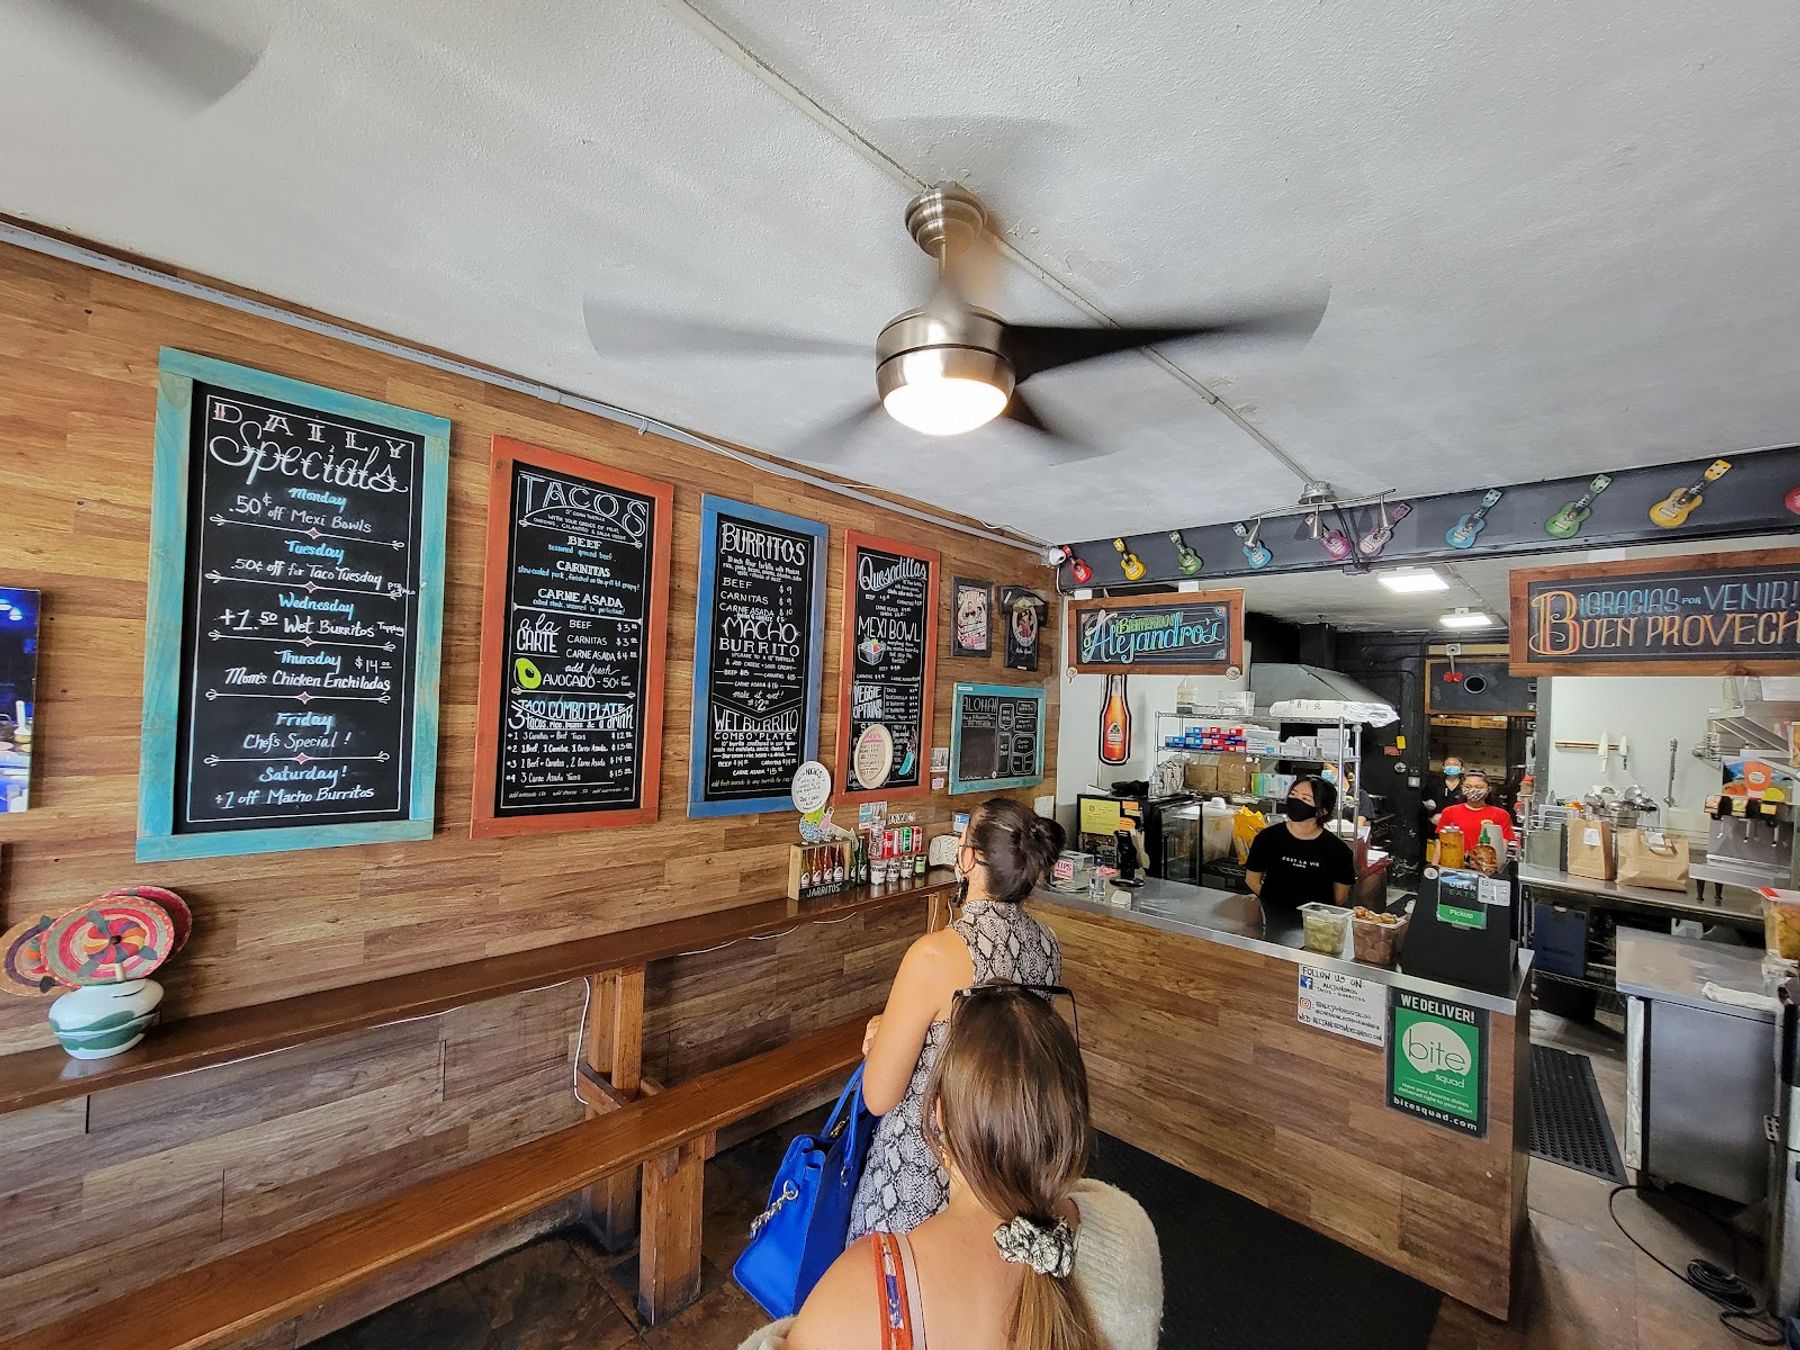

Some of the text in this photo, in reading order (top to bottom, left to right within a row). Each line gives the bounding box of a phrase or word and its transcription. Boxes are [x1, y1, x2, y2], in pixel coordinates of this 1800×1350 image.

[212, 402, 406, 459] DAILY
[209, 421, 408, 492] Specials
[288, 488, 347, 512] Monday
[522, 474, 646, 537] TACOS
[268, 506, 286, 522] off
[290, 509, 325, 526] Mexi
[331, 516, 372, 534] Bowls
[284, 540, 344, 565] Tuesday
[567, 535, 603, 550] BEEF
[721, 522, 805, 566] BURRITOS
[266, 560, 285, 576] off
[287, 564, 304, 576] for
[306, 563, 334, 581] Taco
[335, 566, 382, 590] Tuesday
[556, 560, 611, 578] CARNITAS
[859, 556, 927, 592] Quesadillas
[722, 577, 752, 589] BEEF
[278, 594, 354, 620] Wednesday
[538, 588, 581, 603] CARNE
[582, 593, 624, 609] ASADA
[720, 590, 769, 606] CARNITAS
[720, 602, 750, 613] CARNE
[750, 607, 774, 618] ASADA
[283, 615, 312, 634] Wet
[319, 620, 375, 638] Burritos
[569, 620, 593, 629] BEEF
[721, 617, 800, 644] MACHO
[858, 616, 920, 642] MEXI BOWL
[1529, 591, 1636, 655] BUEN
[517, 629, 560, 654] CARTE
[567, 634, 608, 646] CARNITAS
[719, 637, 800, 658] BURRITO
[274, 650, 341, 673] Thursday
[566, 648, 616, 662] CARNE ASADA
[225, 667, 390, 690] Mom's Chicken Enchiladas
[565, 662, 583, 673] add
[543, 674, 596, 688] AVOCADO
[508, 704, 526, 730] 3
[518, 700, 626, 720] TACO COMBO PLATE
[714, 705, 799, 732] WET BURRITO
[275, 712, 333, 734] Friday
[243, 734, 280, 753] Chef's
[284, 731, 336, 751] Special
[714, 732, 753, 740] COMBO
[238, 790, 260, 804] off
[267, 788, 312, 806] Macho
[316, 784, 374, 802] Burritos
[807, 883, 841, 898] JARRITOS
[1449, 888, 1476, 899] EATS
[1450, 908, 1474, 919] Pickup
[1302, 966, 1330, 980] FOLLOW
[1334, 974, 1346, 984] US
[1400, 994, 1475, 1024] WE DELIVER!
[1408, 1028, 1466, 1070] bite
[1435, 1074, 1465, 1088] squad
[1393, 1096, 1477, 1131] bitesquad.com
